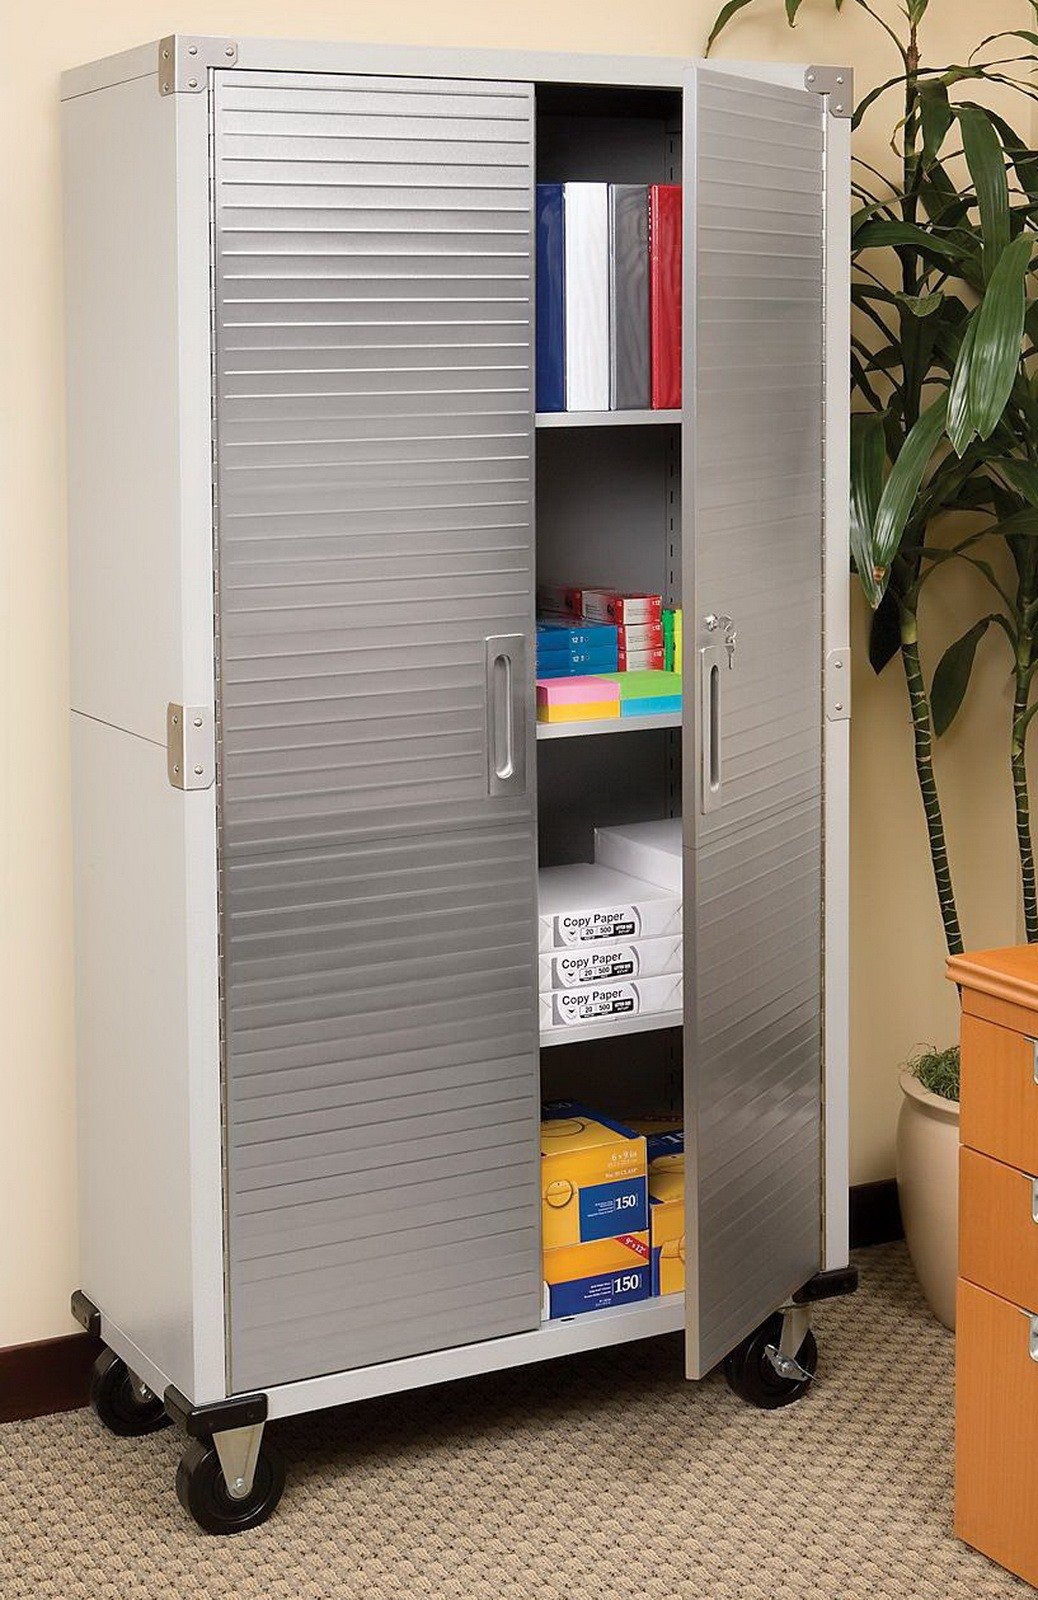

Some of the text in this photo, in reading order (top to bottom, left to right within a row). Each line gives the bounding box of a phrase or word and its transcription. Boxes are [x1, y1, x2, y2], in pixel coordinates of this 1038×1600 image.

[563, 912, 624, 928] Copy Paper
[562, 953, 622, 969] Copy Paper
[598, 966, 610, 974] 500
[562, 989, 623, 1005] Copy Paper
[598, 1003, 611, 1011] 500
[616, 1194, 636, 1210] 150
[614, 1274, 639, 1293] 150
